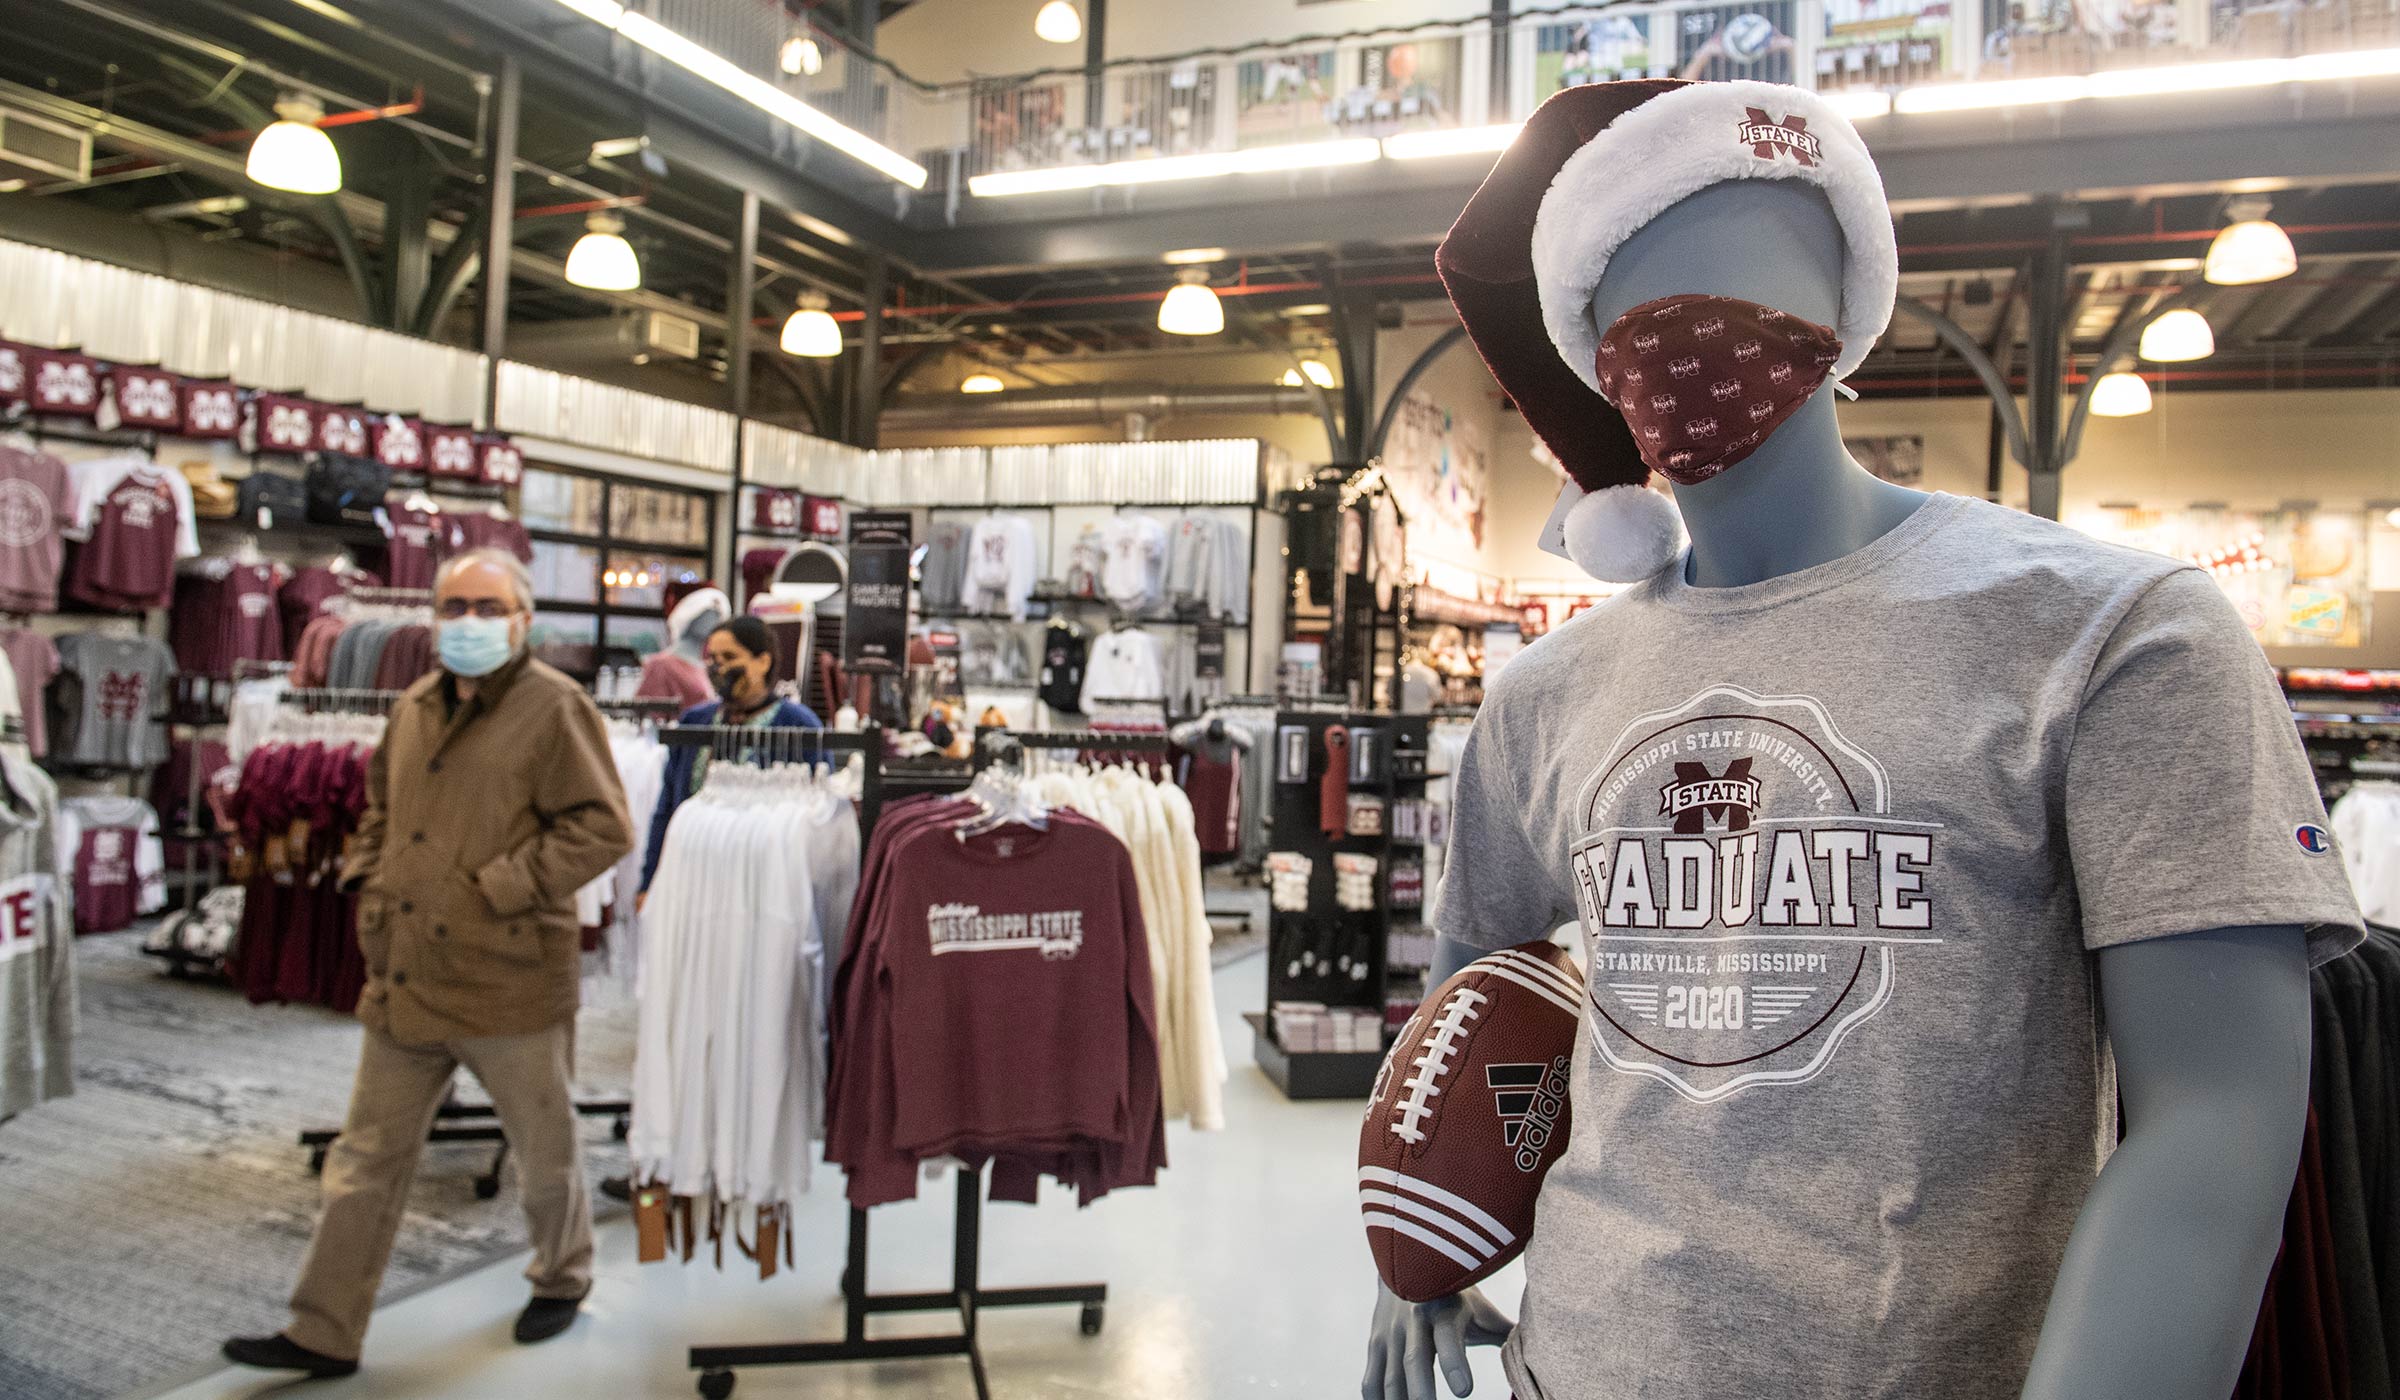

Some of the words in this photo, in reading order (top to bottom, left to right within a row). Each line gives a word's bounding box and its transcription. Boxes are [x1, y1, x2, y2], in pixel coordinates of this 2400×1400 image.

[1751, 126, 1808, 151] STATE
[1596, 739, 1678, 823] MISSISSIPPI
[1686, 731, 1743, 750] STATE
[1678, 781, 1748, 807] STATE
[1031, 911, 1083, 946] STATE
[1596, 952, 1711, 976] STARKVILLE,
[1716, 954, 1828, 973] MISSISSIPPI
[1664, 985, 1744, 1030] 2020
[1515, 1055, 1571, 1173] adidas
